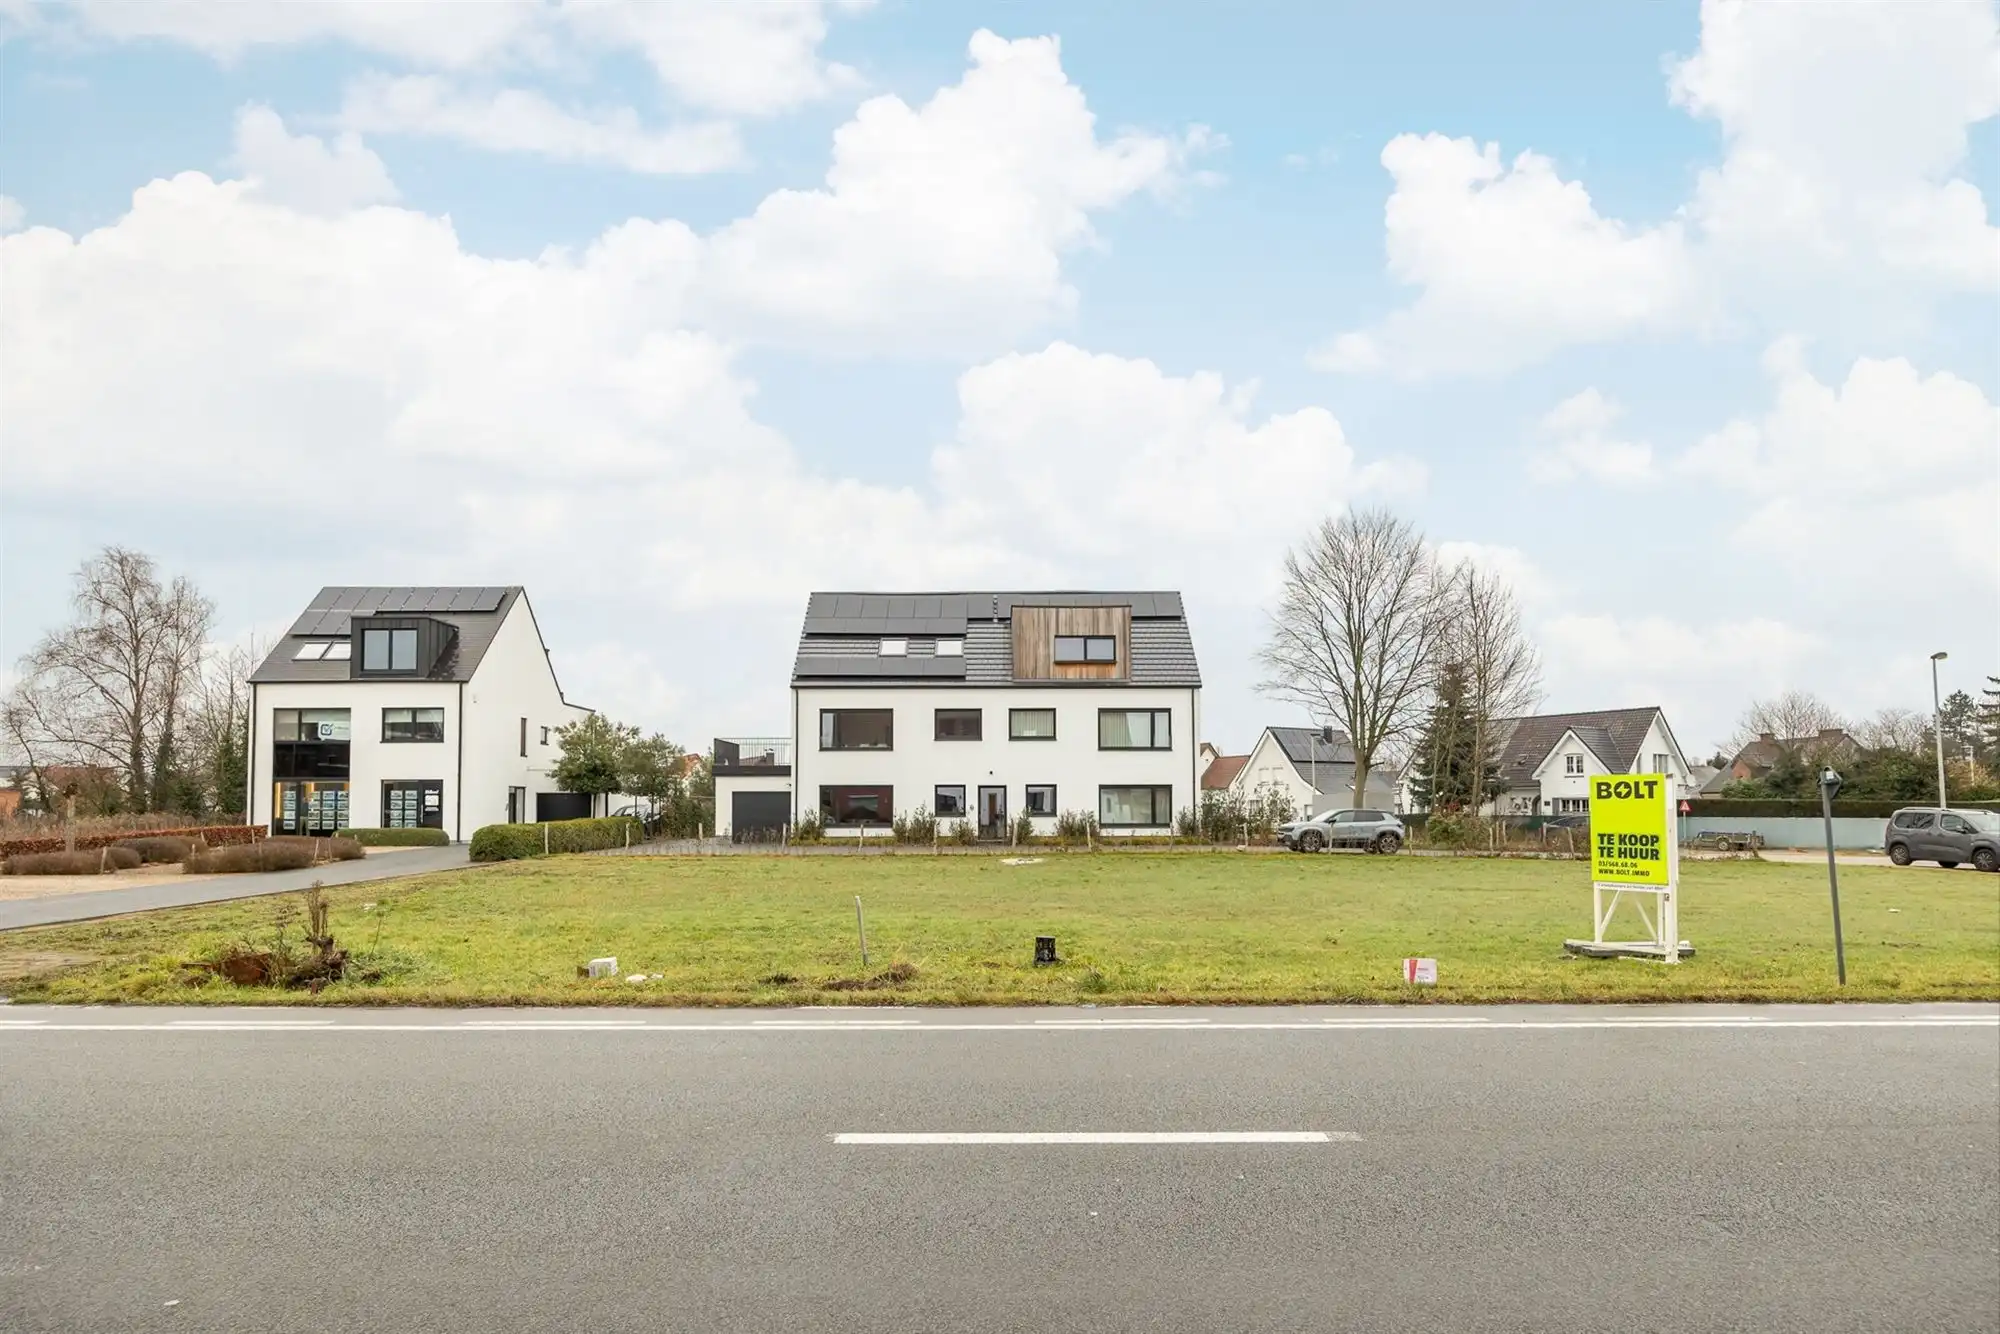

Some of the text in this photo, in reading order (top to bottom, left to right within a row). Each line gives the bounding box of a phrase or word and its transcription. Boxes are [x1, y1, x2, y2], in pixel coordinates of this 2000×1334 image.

[1596, 781, 1658, 799] BOLT
[1598, 833, 1660, 847] TE KOOP
[1598, 846, 1660, 860] TE HUUR
[1598, 868, 1650, 877] WWW.BOLT.IMMO
